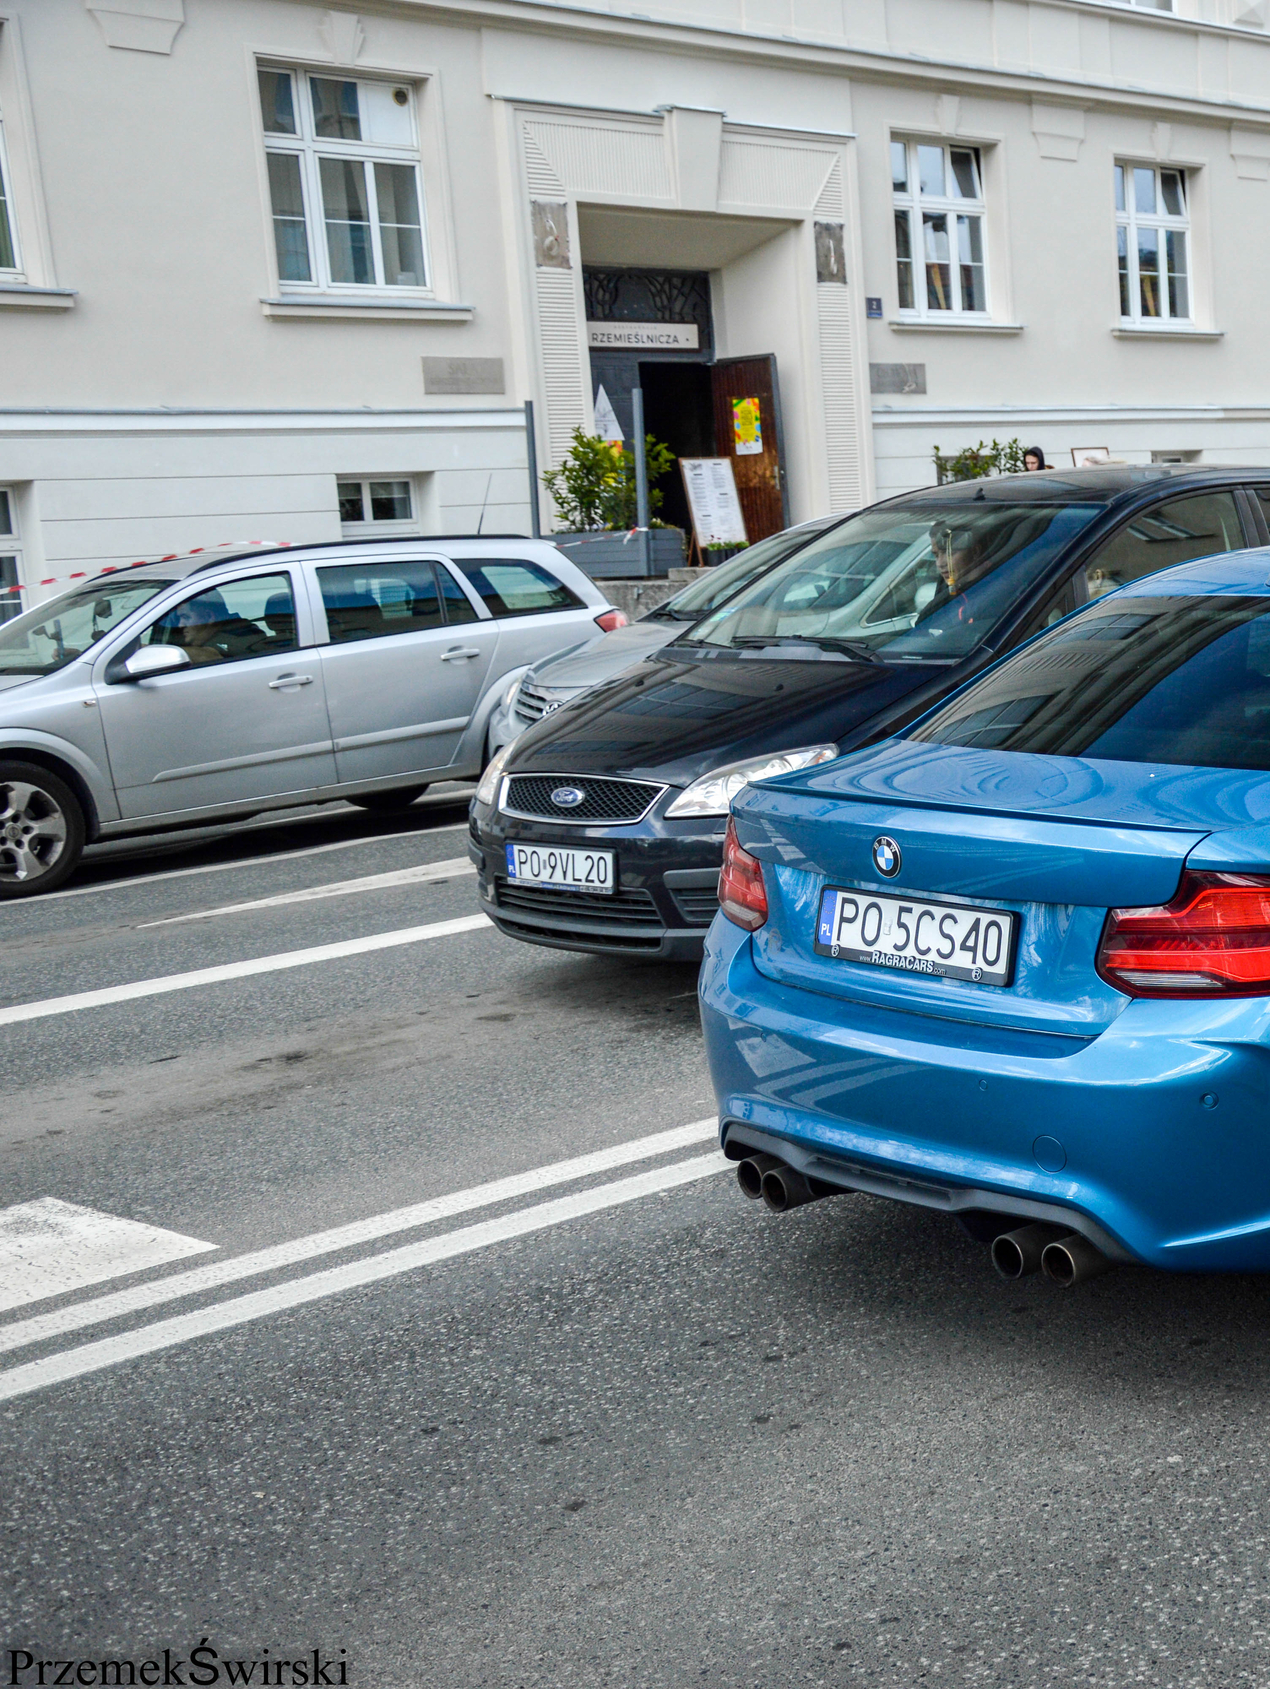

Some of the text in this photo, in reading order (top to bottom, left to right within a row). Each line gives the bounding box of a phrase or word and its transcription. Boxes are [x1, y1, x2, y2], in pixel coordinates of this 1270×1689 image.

[591, 331, 680, 344] RZEMIEŚLNICZA
[517, 848, 608, 884] PO 9VL20
[820, 923, 831, 936] PL
[836, 896, 1003, 967] PO 5CS40
